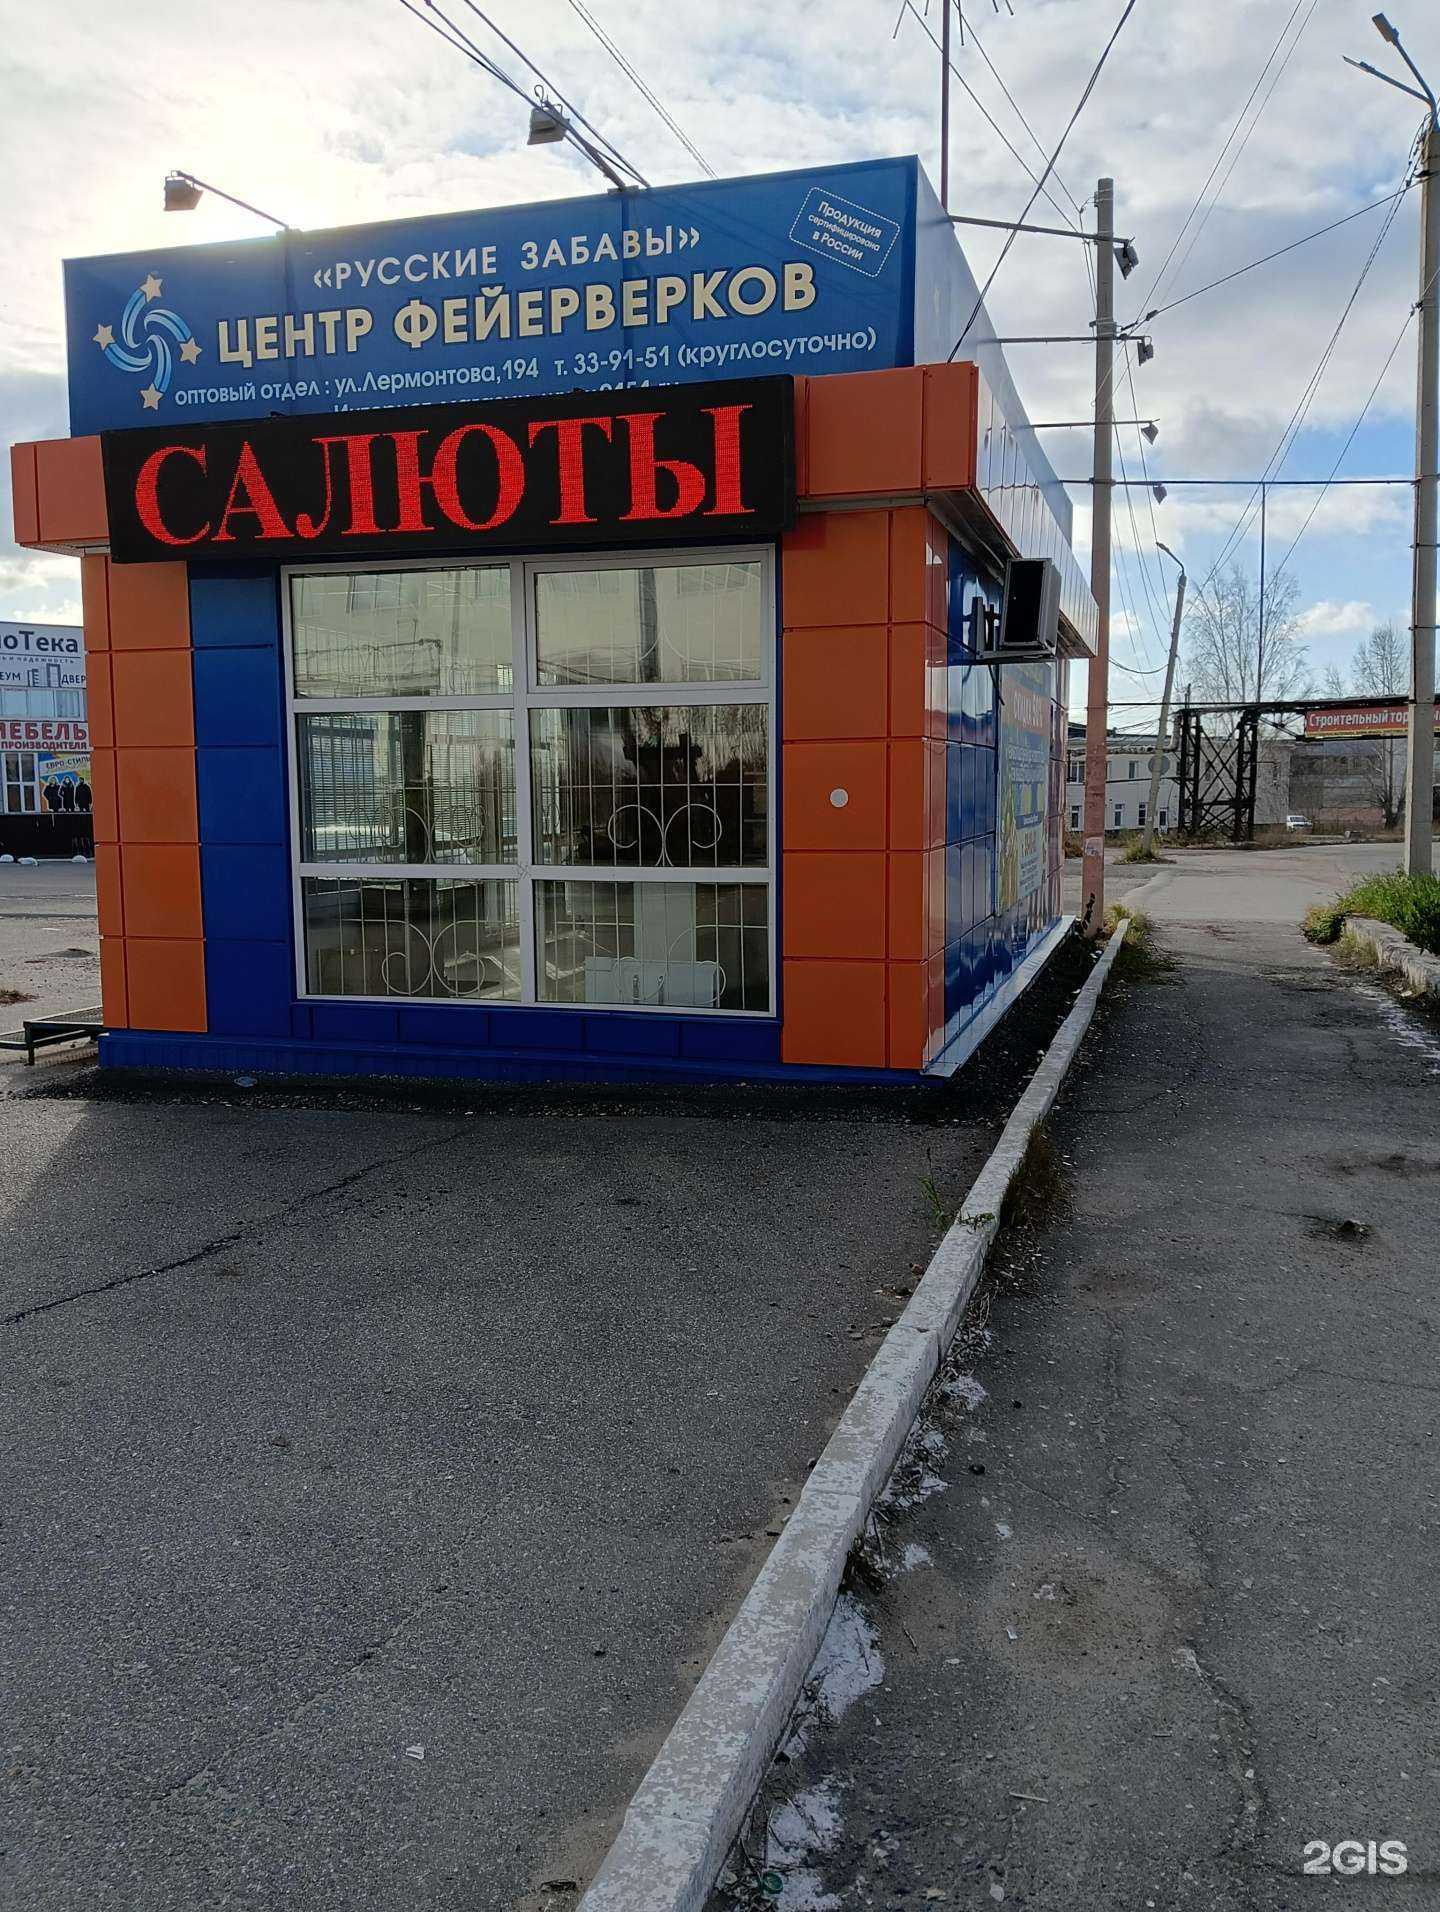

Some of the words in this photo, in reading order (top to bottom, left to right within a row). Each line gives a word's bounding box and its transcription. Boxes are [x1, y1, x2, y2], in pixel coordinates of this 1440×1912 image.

[808, 214, 881, 252] сертифицирована
[818, 201, 882, 238] Продукция
[313, 245, 497, 289] «РУССКИЕ
[520, 225, 701, 269] ЗАБАВЫ»
[812, 230, 820, 241] в
[821, 232, 864, 260] России
[218, 308, 373, 368] ЦЕНТР
[394, 262, 816, 348] ФЕЙЕРВЕРКОВ
[175, 384, 256, 406] оптовый
[260, 378, 320, 401] отдел
[573, 344, 670, 374] 33-91-51
[677, 326, 877, 367] (круглосуточно)
[135, 404, 755, 545] САЛЮТЫ
[0, 630, 78, 653] оТека
[1309, 710, 1388, 729] Строительный
[1, 740, 88, 752] ПРОИЗВОДИТЕЛЯ
